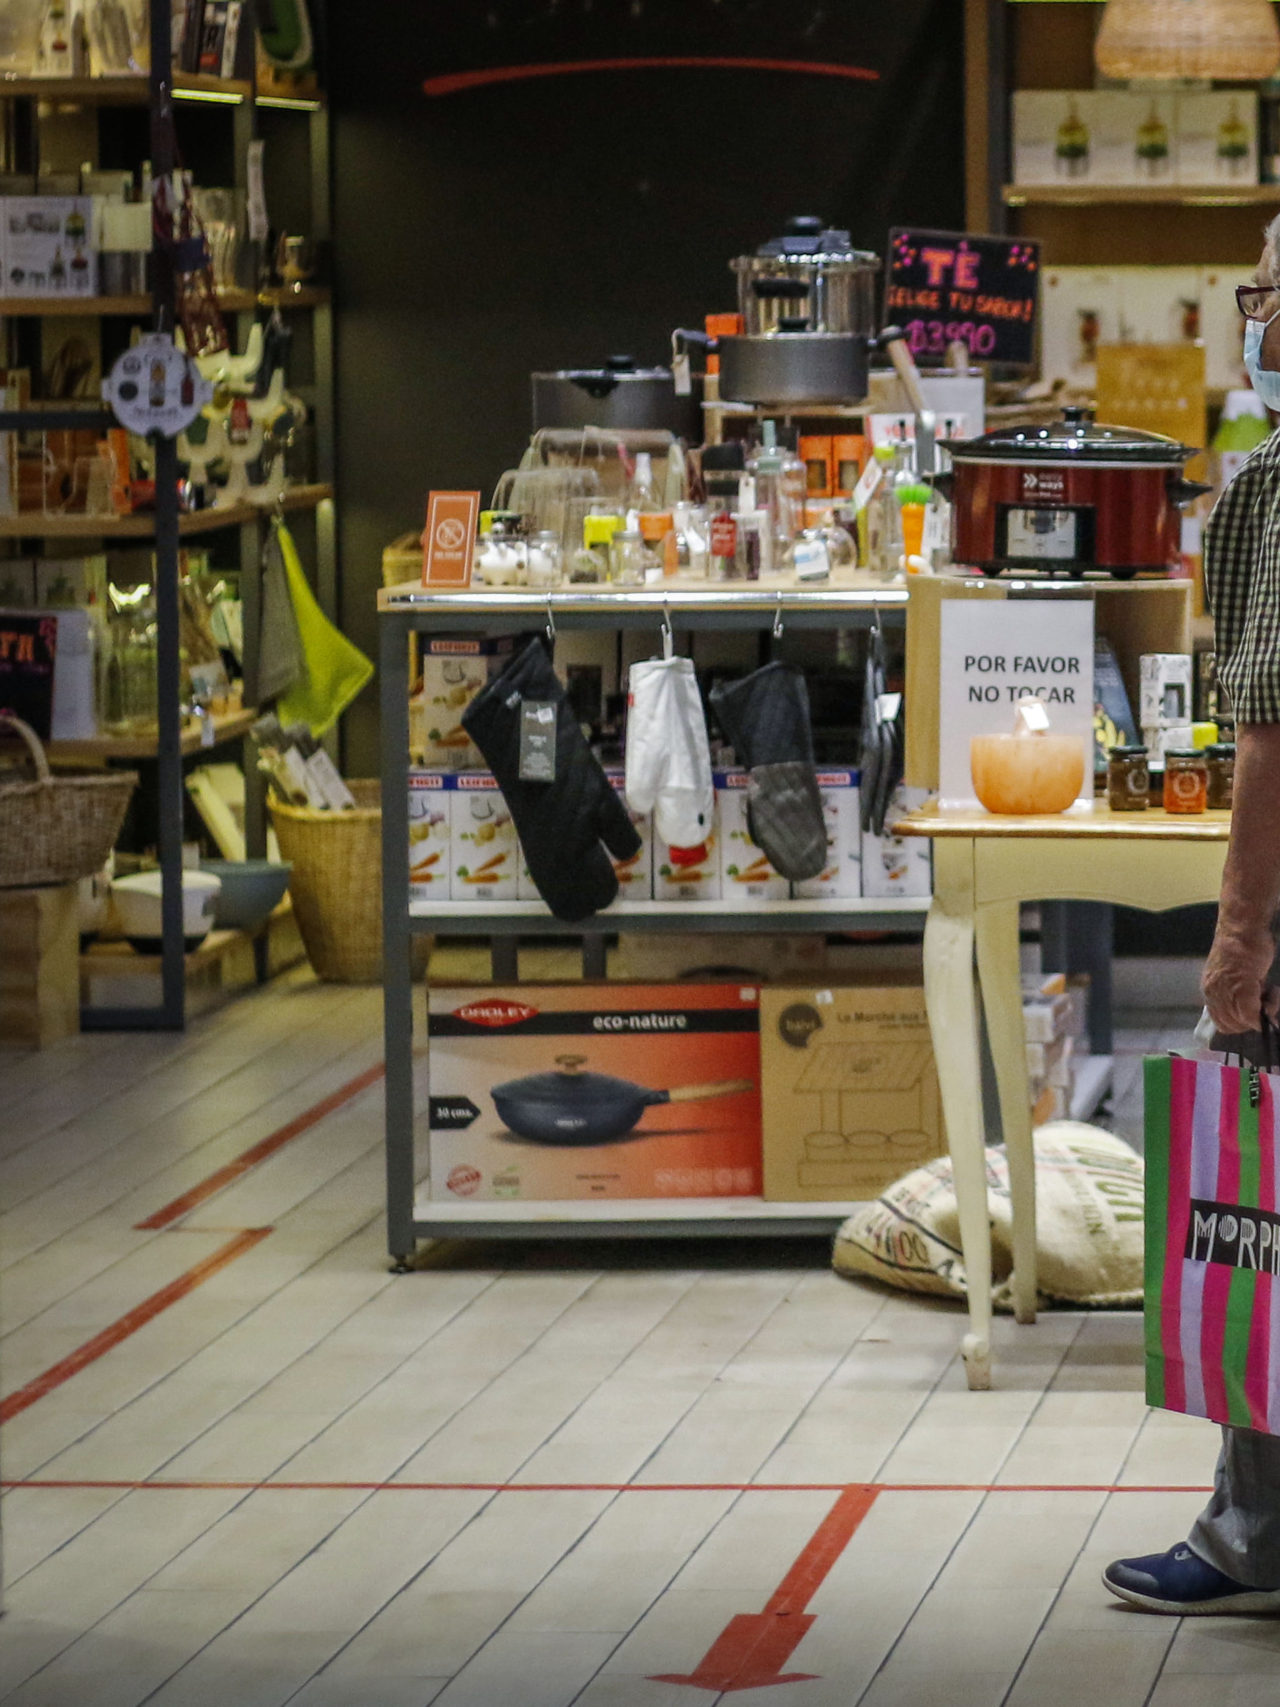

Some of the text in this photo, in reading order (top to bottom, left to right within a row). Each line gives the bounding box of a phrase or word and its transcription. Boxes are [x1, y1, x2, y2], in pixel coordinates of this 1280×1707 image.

[964, 656, 1080, 673] POR FAVOR
[968, 686, 1000, 702] NO
[593, 1014, 688, 1029] eco-nature
